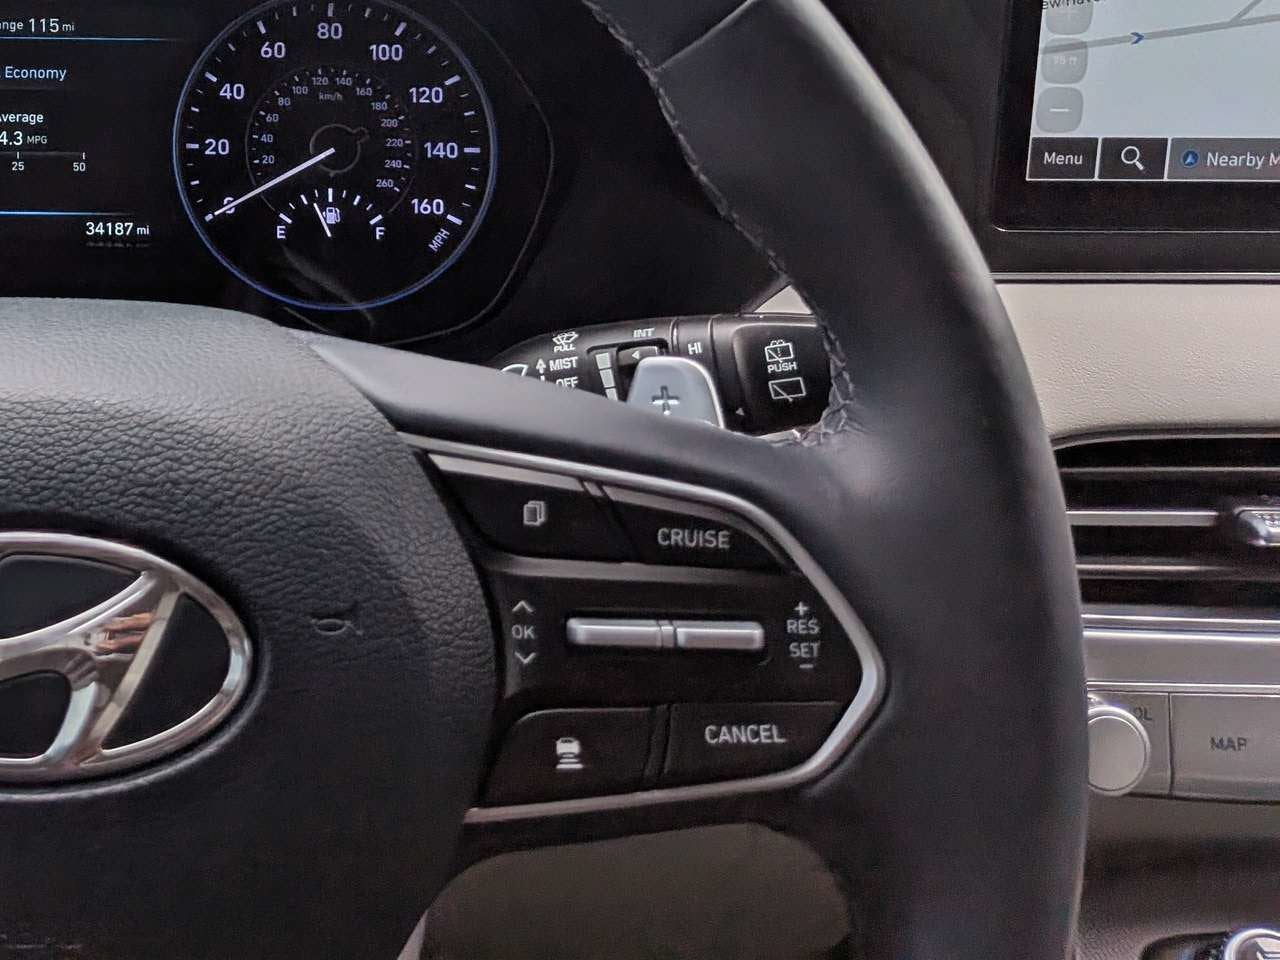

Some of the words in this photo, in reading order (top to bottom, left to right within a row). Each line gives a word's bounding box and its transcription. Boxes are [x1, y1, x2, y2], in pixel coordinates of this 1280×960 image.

[28, 18, 60, 33] 115
[62, 23, 75, 32] mi
[317, 23, 343, 40] 80
[260, 42, 287, 58] 60
[369, 44, 403, 61] 100
[5, 66, 67, 82] Economy
[312, 76, 329, 86] 120
[336, 77, 353, 87] 140
[219, 83, 245, 100] 40
[292, 86, 308, 95] 100
[319, 91, 343, 102] km/h
[356, 87, 372, 97] 160
[409, 87, 443, 103] 120
[278, 97, 291, 107] 80
[371, 101, 388, 111] 180
[266, 113, 279, 123] 60
[381, 118, 398, 128] 200
[26, 135, 48, 145] MPG
[261, 133, 274, 144] 40
[386, 137, 404, 147] 220
[204, 139, 230, 156] 20
[423, 142, 458, 159] 140
[262, 154, 275, 165] 20
[385, 159, 402, 169] 240
[1043, 150, 1083, 165] Menu
[1207, 151, 1265, 170] Nearby
[11, 161, 25, 172] 25
[72, 161, 86, 172] 50
[376, 178, 394, 189] 260
[411, 198, 444, 215] 160
[85, 221, 134, 236] 34187
[136, 224, 150, 235] mi
[276, 225, 287, 239] E
[375, 226, 386, 240] F
[429, 228, 449, 254] MPH
[633, 328, 655, 338] INT
[553, 344, 576, 353] PULL
[687, 341, 703, 356] HI
[549, 356, 579, 372] MIST
[766, 360, 798, 374] PUSH
[657, 526, 731, 549] CRUISE
[511, 624, 536, 640] OK
[786, 618, 819, 635] RES
[789, 642, 820, 658] SET
[704, 724, 785, 744] CANCEL
[1209, 736, 1247, 752] MAP
